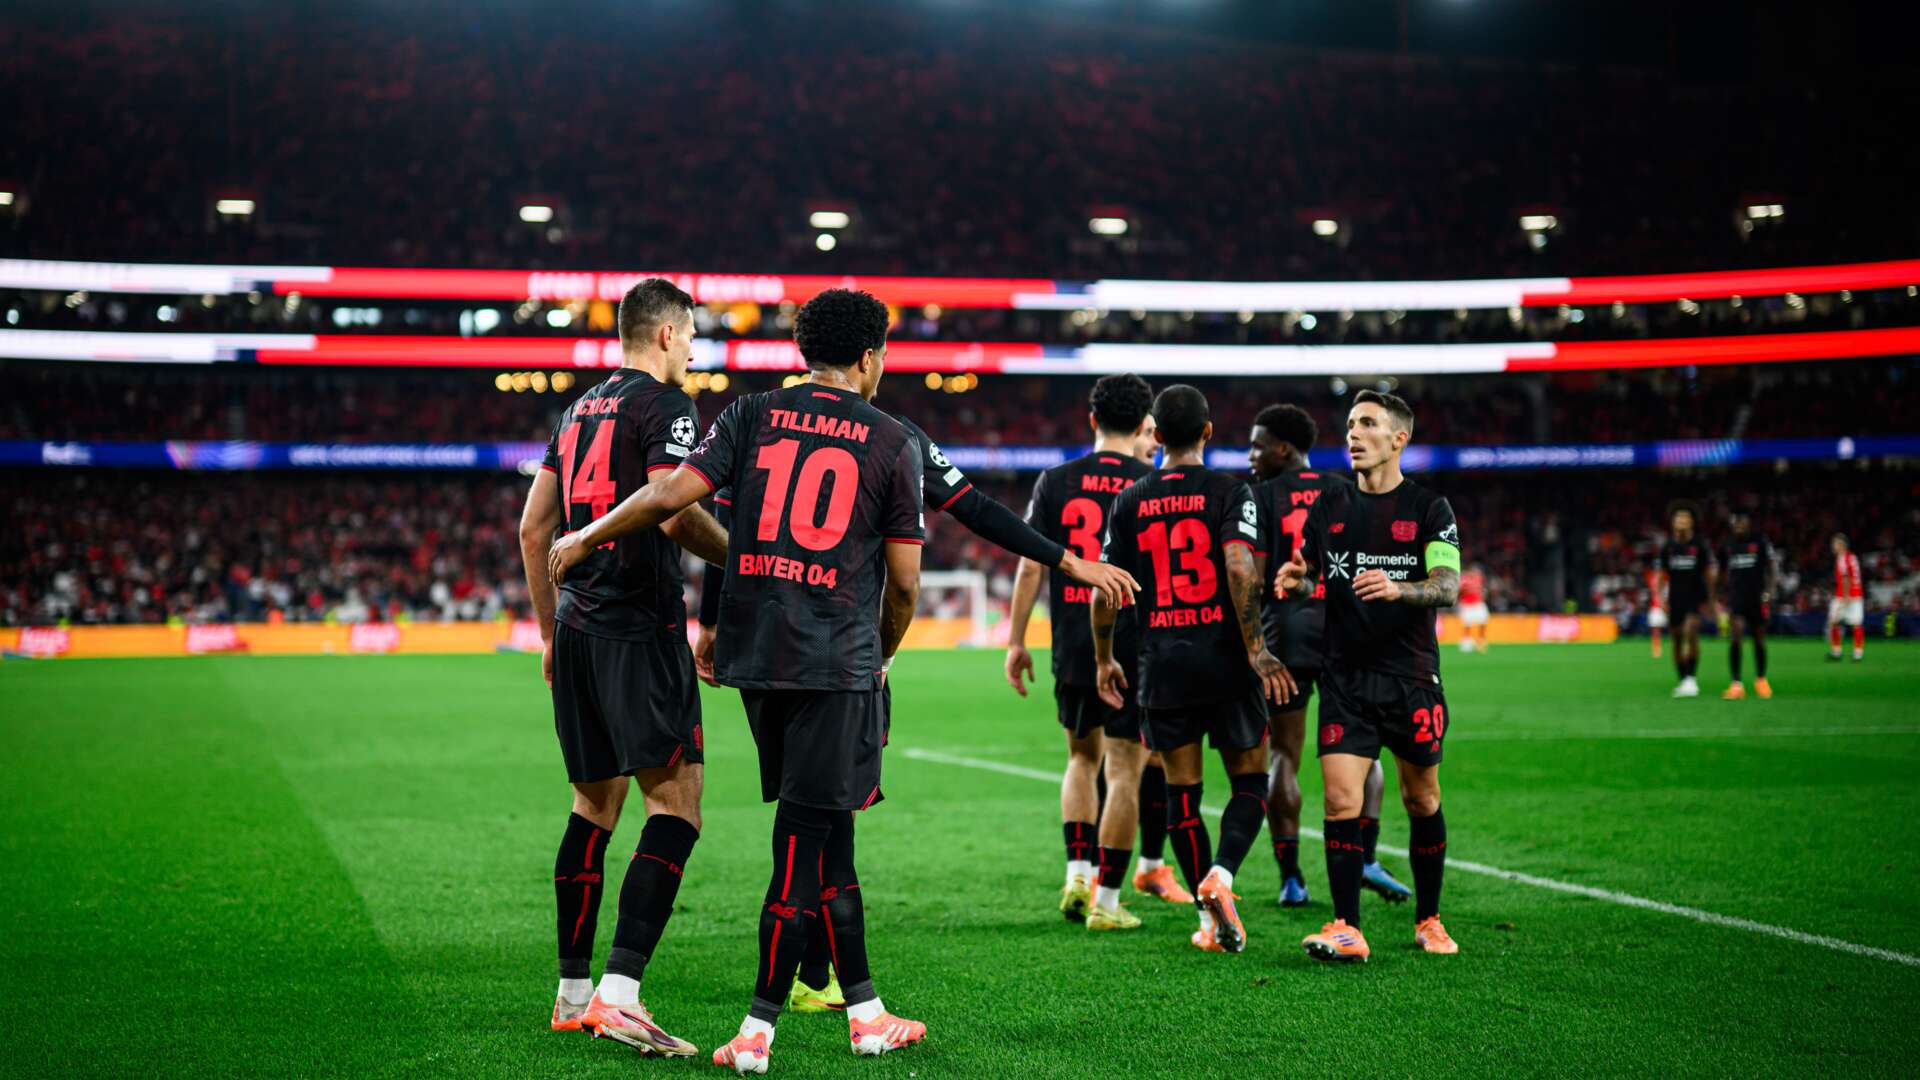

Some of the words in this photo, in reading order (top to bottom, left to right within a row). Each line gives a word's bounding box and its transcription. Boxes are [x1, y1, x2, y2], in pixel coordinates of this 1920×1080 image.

[769, 409, 870, 444] TILLMAN
[557, 419, 617, 523] 14
[755, 438, 860, 552] 10
[1138, 495, 1206, 517] ARTHUR
[1061, 498, 1103, 562] 3
[1280, 507, 1308, 562] 1
[739, 554, 804, 583] BAYER
[806, 563, 838, 589] 04
[1138, 518, 1217, 606] 13
[1356, 552, 1418, 566] Barmenia
[1063, 585, 1092, 604] BAY
[1200, 606, 1223, 623] 04
[1412, 704, 1445, 743] 20
